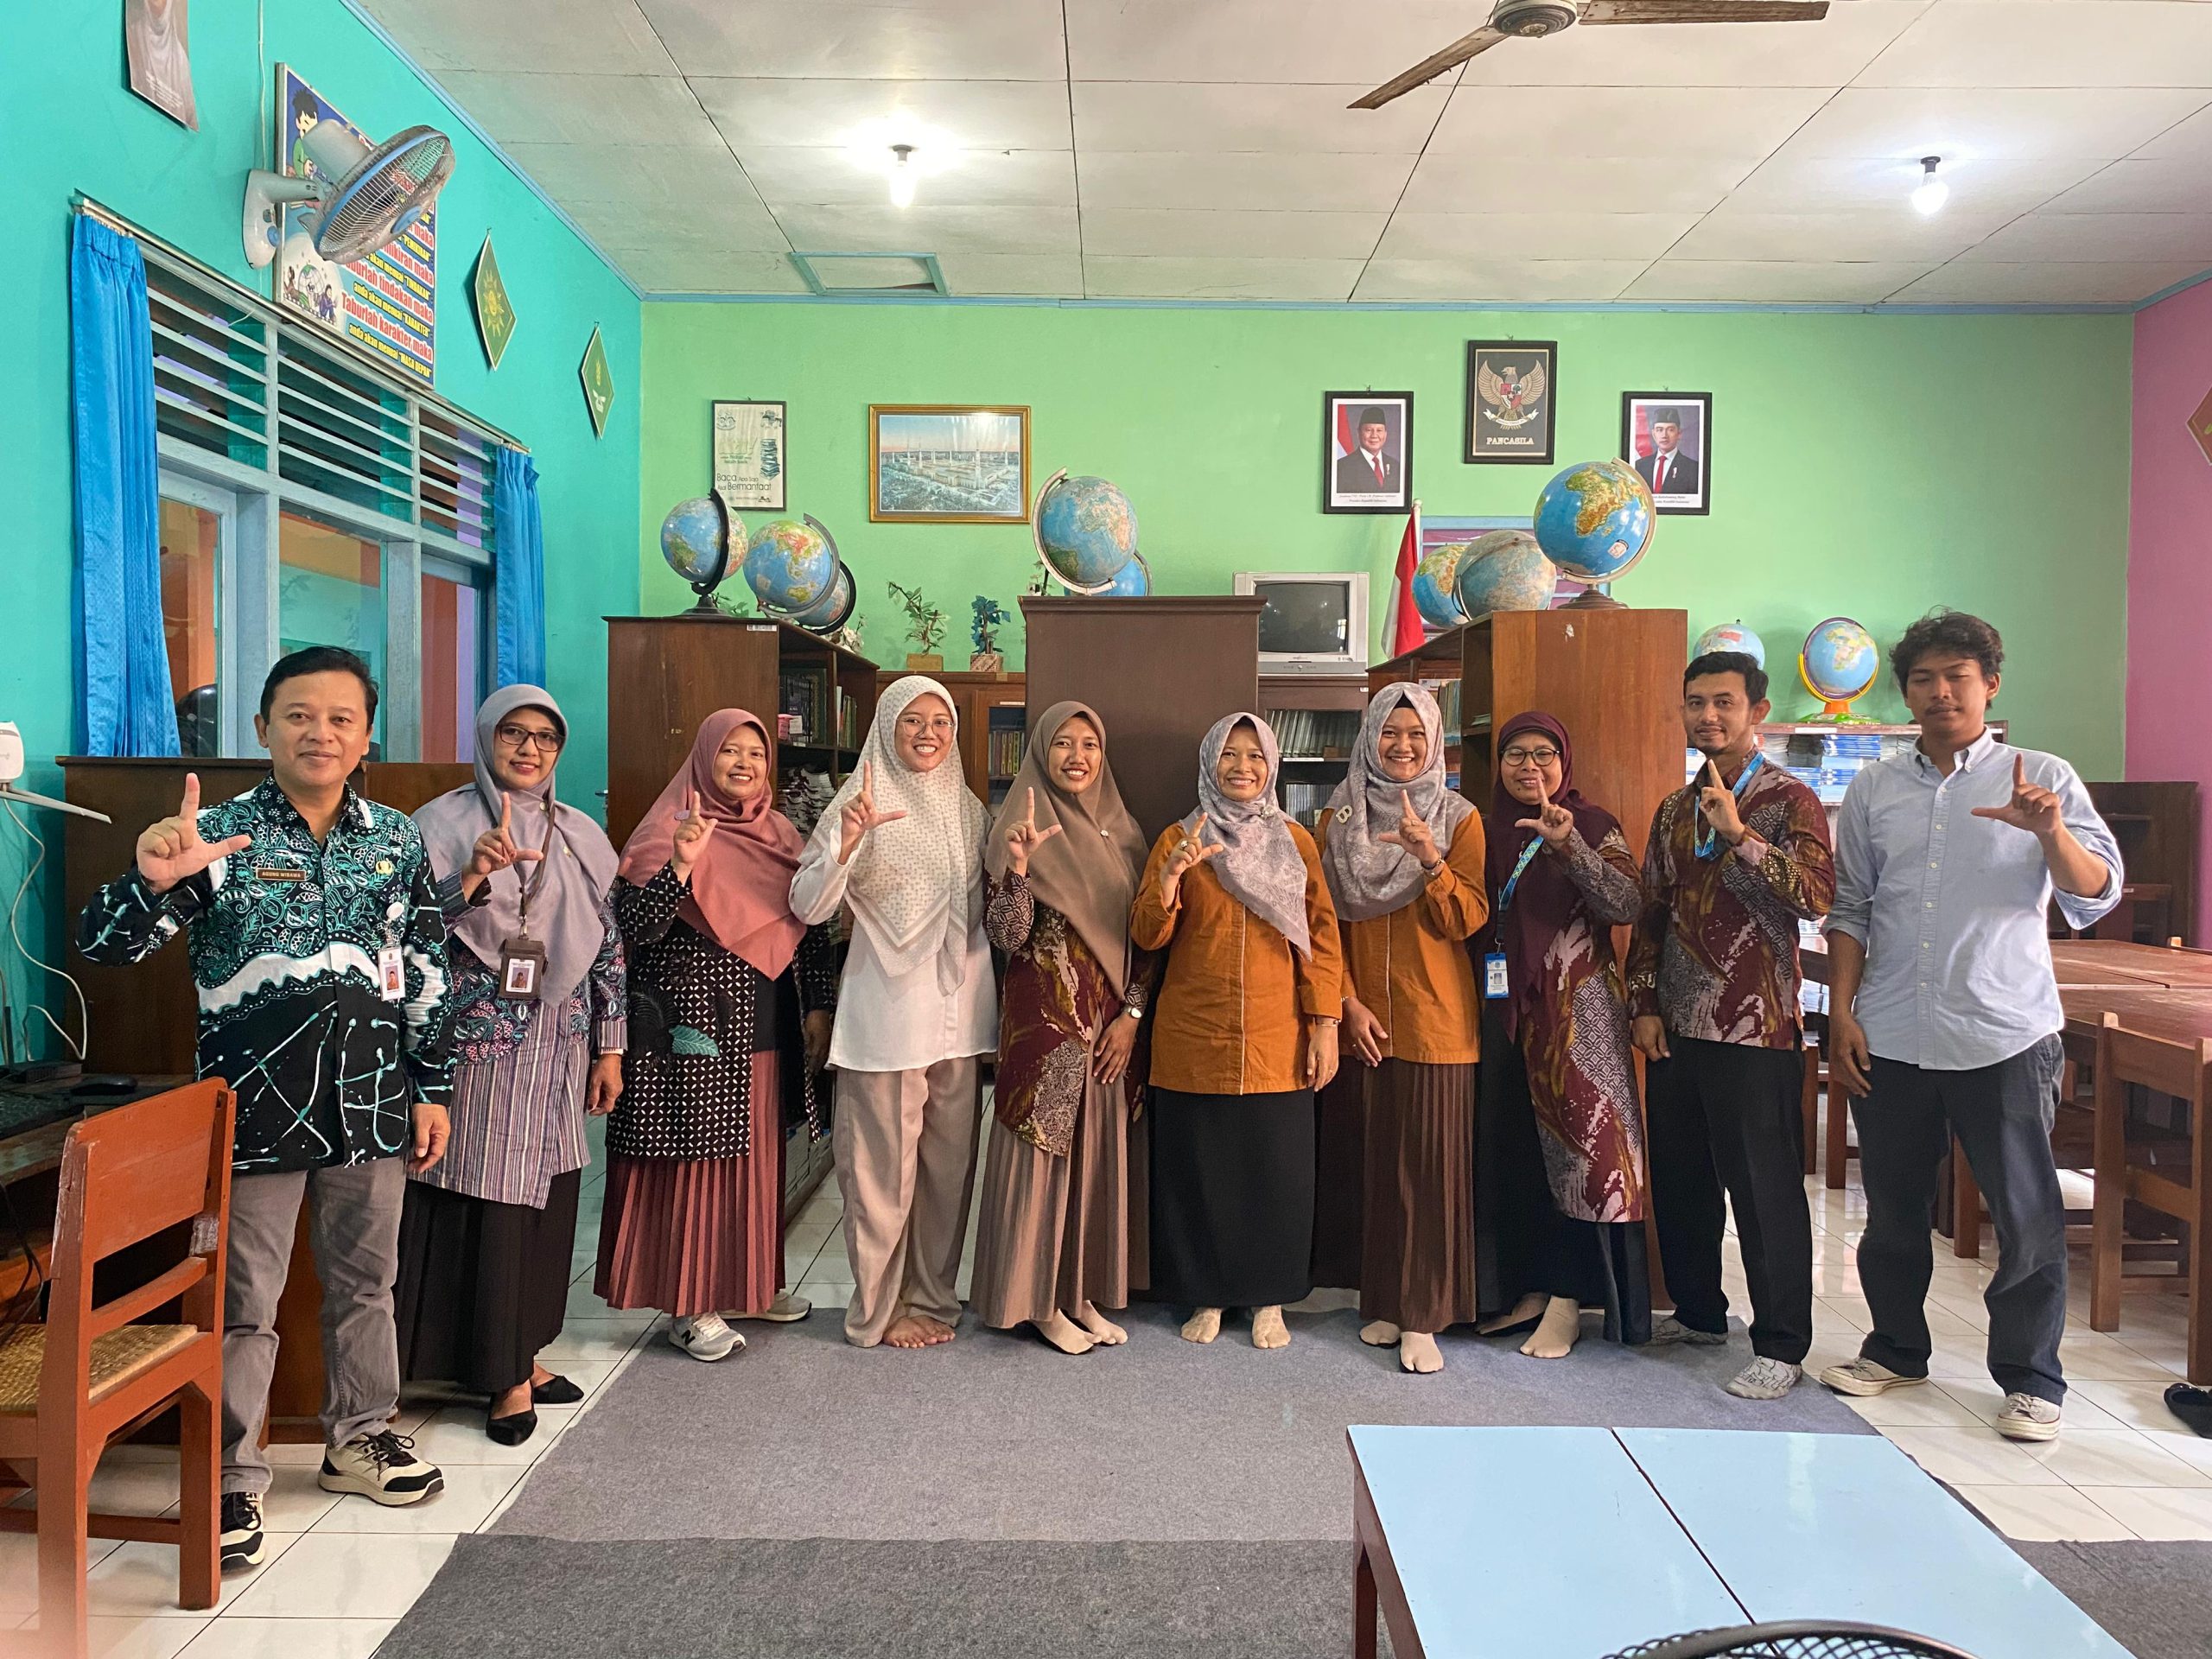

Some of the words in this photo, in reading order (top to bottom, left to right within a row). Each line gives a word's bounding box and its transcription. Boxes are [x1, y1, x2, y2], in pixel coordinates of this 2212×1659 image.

[414, 261, 433, 286] maka
[380, 275, 412, 309] tindakan
[414, 300, 433, 323] maka
[342, 291, 378, 328] Taburlah
[413, 338, 433, 361] maka
[716, 473, 737, 481] Baca
[681, 1329, 696, 1345] N
